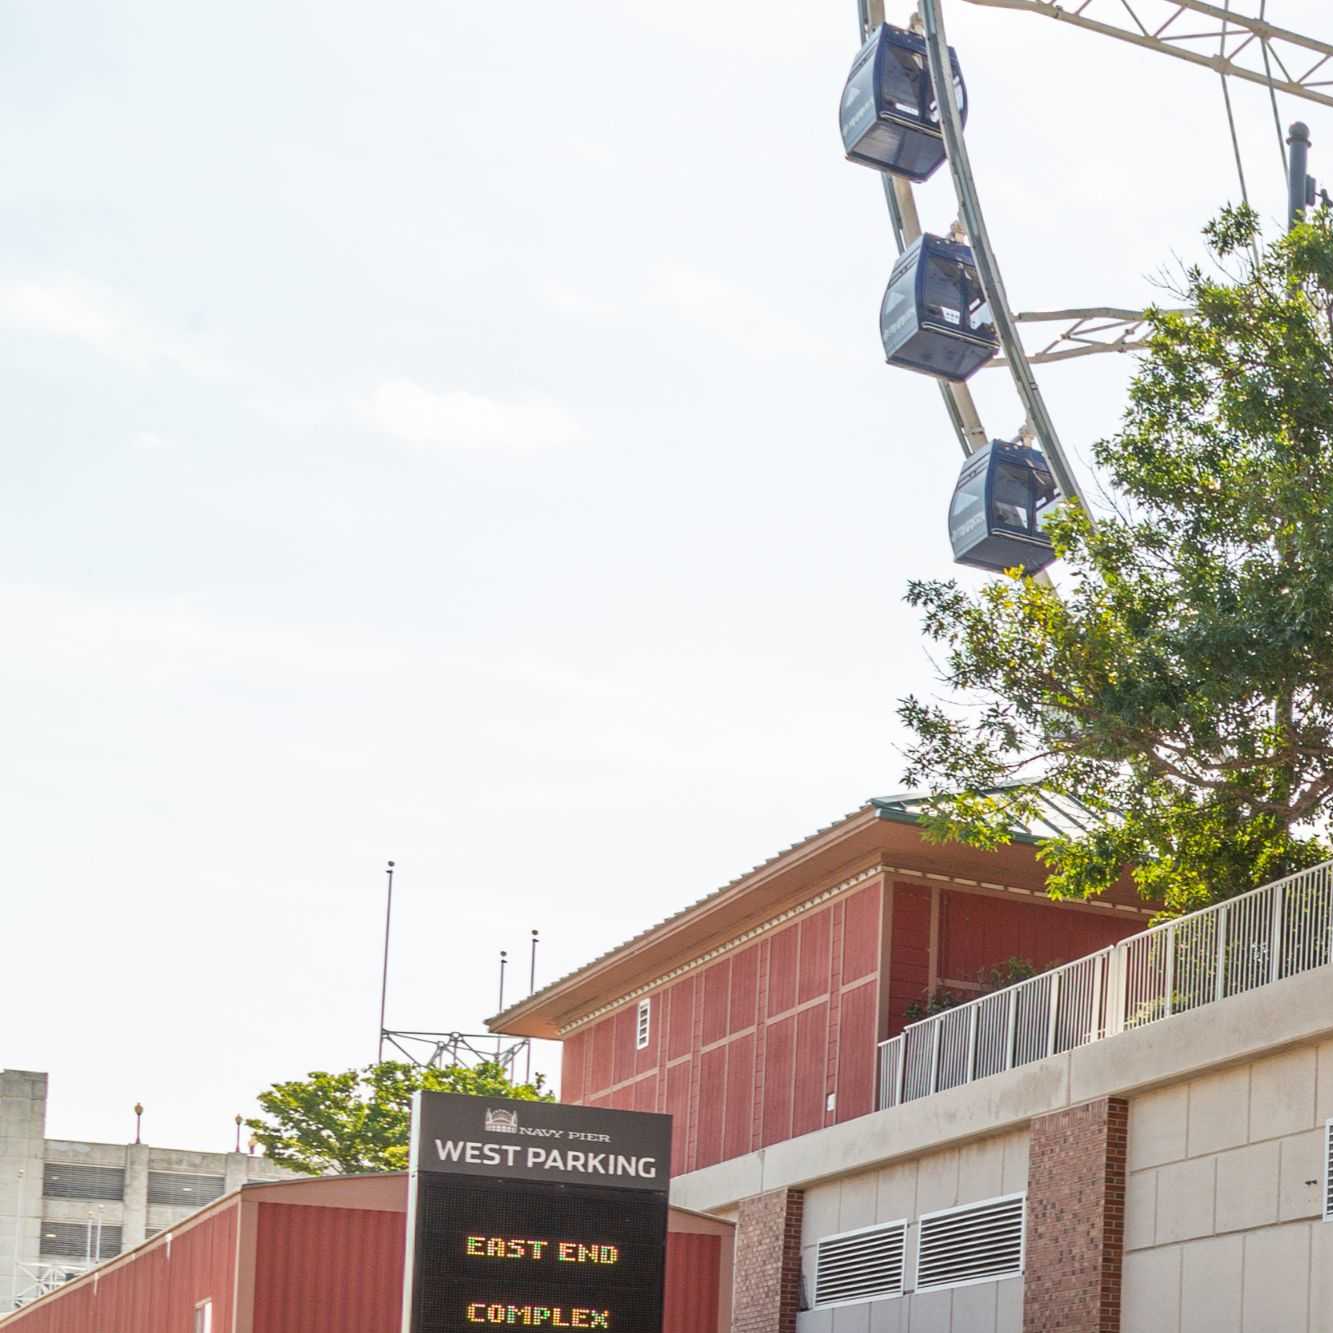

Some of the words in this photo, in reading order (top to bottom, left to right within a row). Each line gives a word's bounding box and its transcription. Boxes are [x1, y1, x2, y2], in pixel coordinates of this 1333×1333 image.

[519, 1126, 564, 1139] NAVY
[568, 1131, 612, 1143] PIER
[434, 1139, 521, 1167] WEST
[527, 1147, 656, 1178] PARKING
[466, 1236, 548, 1260] EAST
[558, 1241, 619, 1264] END
[466, 1303, 609, 1329] COMPLEX
